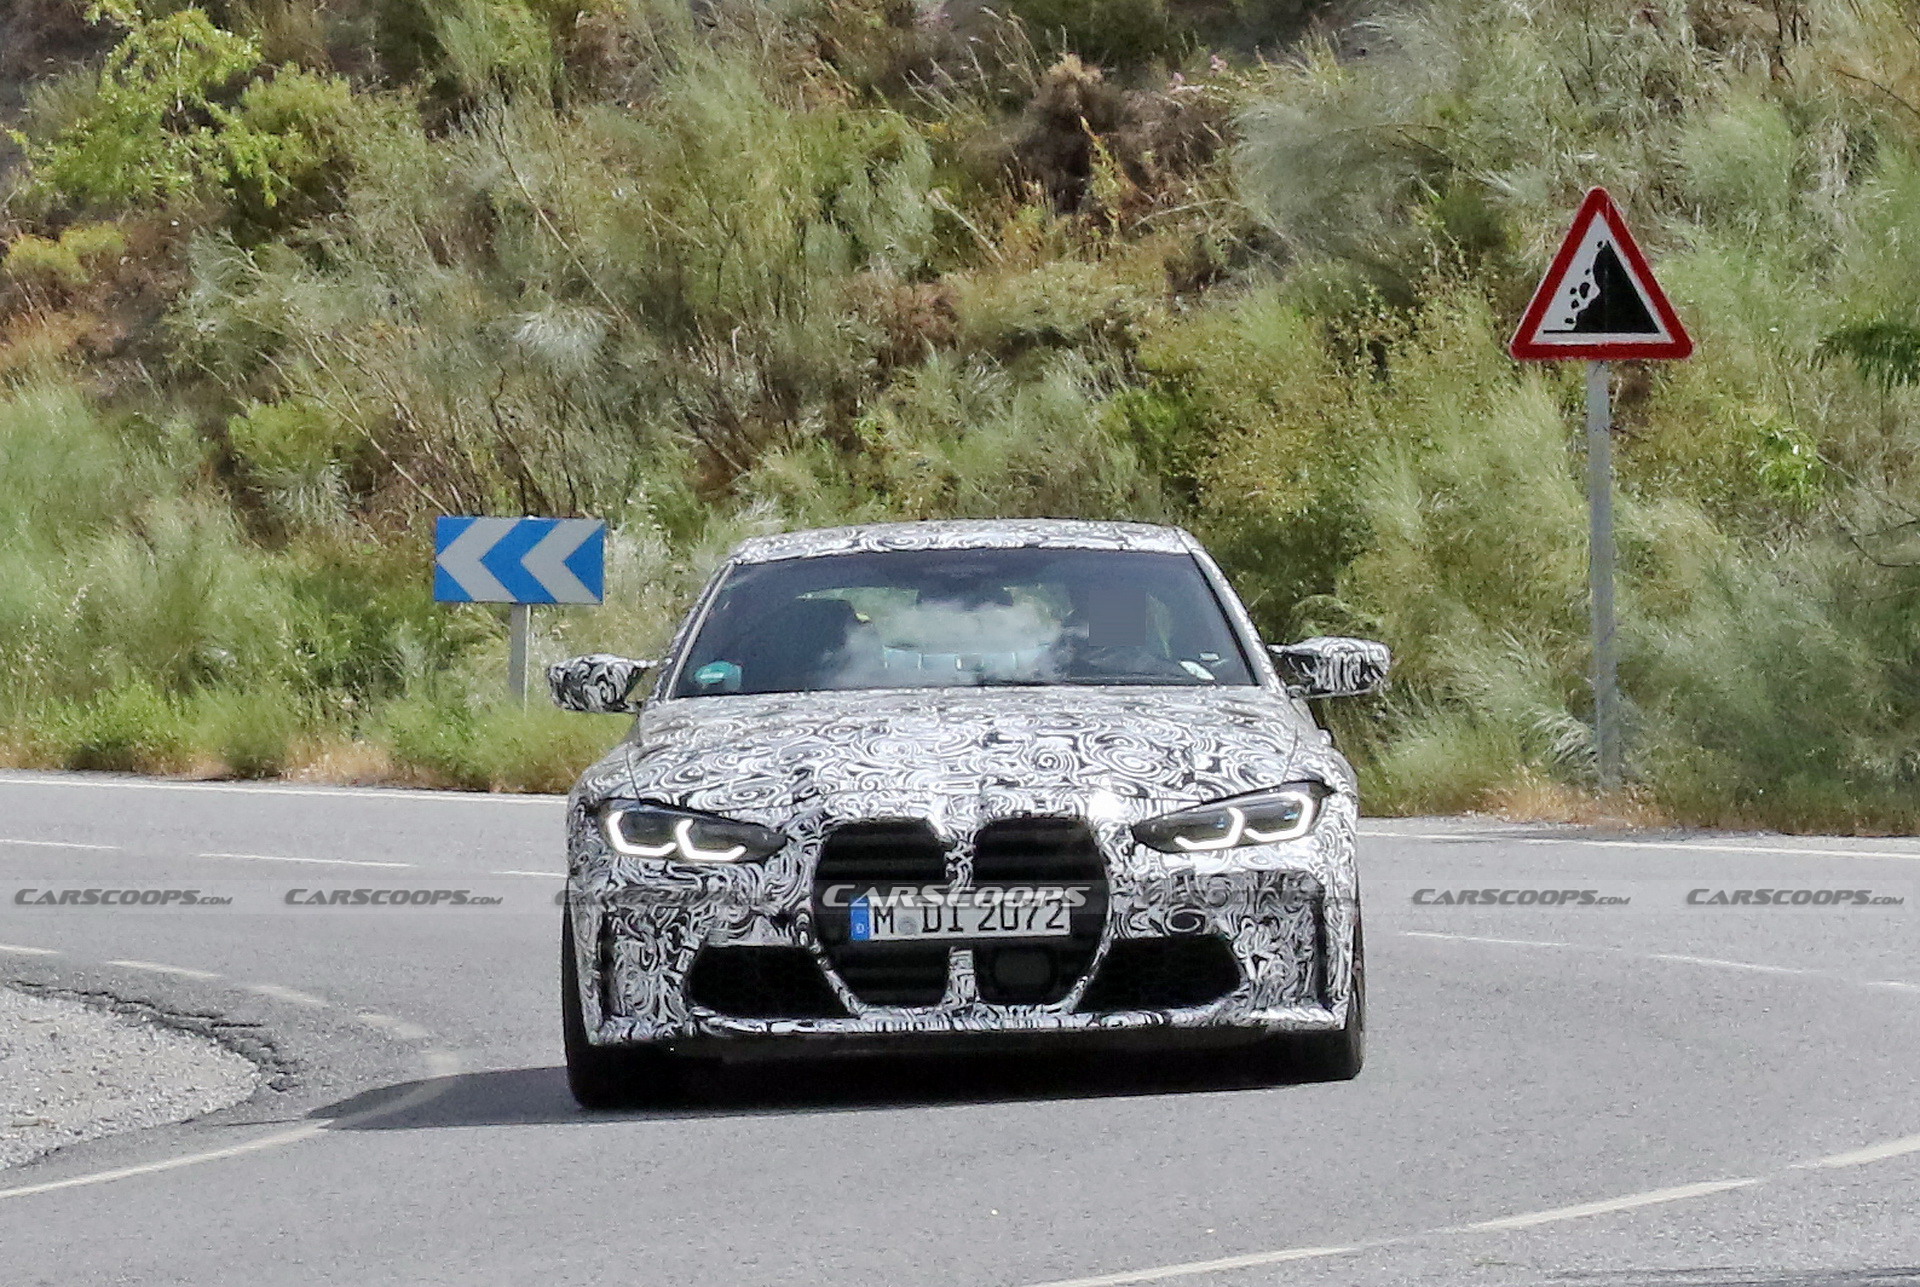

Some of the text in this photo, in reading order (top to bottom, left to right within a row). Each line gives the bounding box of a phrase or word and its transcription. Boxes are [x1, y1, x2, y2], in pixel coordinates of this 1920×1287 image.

[873, 898, 1064, 934] M DI 2072
